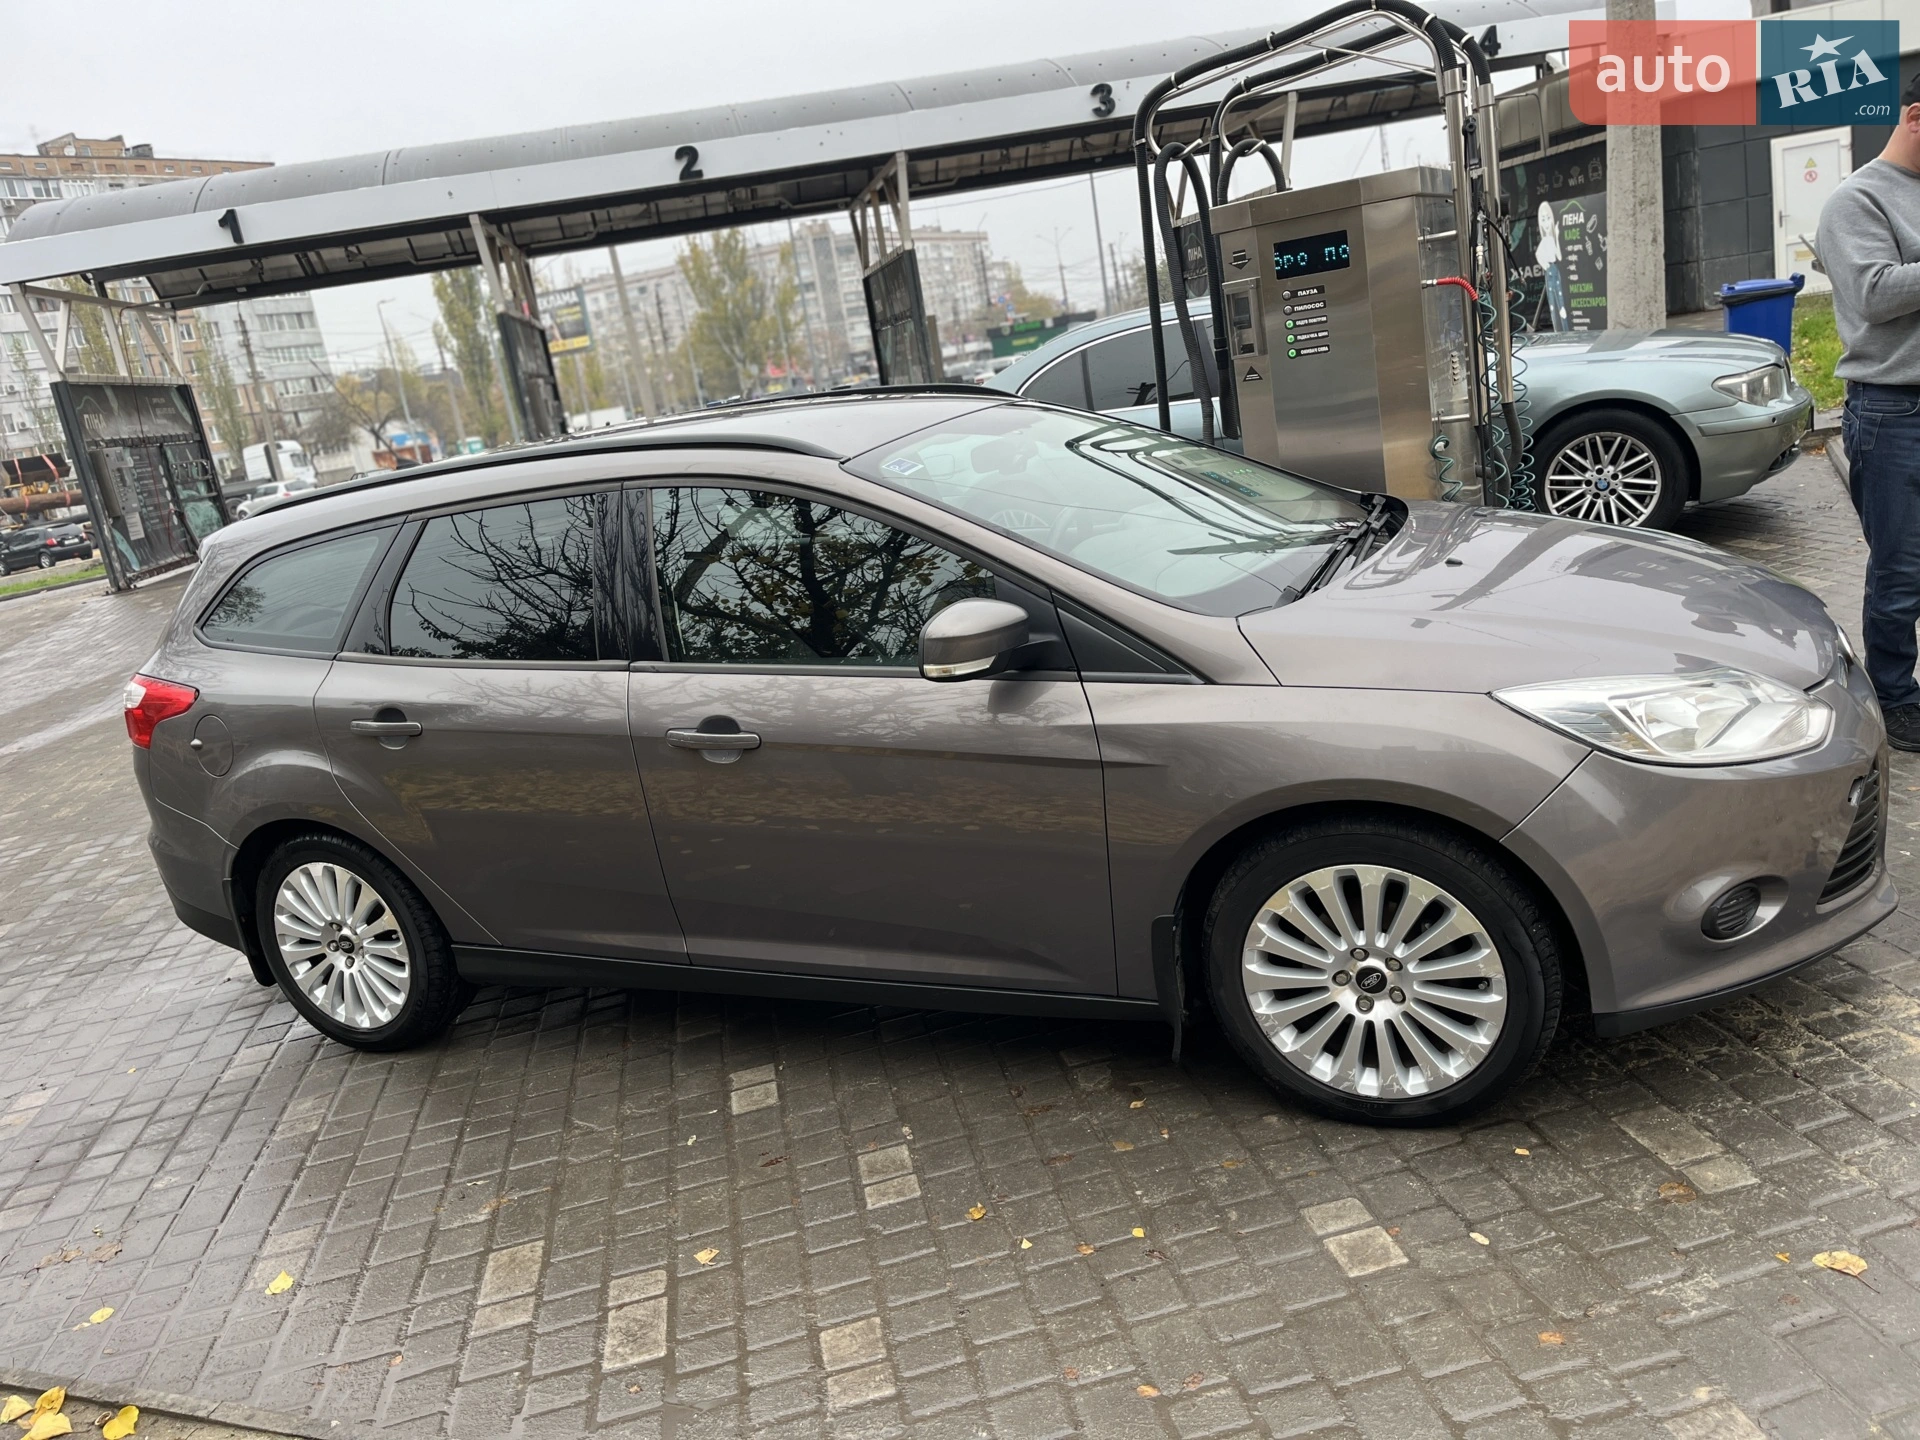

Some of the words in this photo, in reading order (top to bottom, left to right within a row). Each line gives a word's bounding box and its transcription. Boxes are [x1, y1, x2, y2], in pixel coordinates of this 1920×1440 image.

[1478, 24, 1502, 58] 4
[1090, 82, 1116, 118] 3
[674, 145, 704, 182] 2
[217, 208, 245, 245] 1
[1562, 211, 1585, 226] ПЕНА
[1297, 288, 1318, 297] ПАУЗА
[1569, 282, 1593, 293] МАГАЗИН
[537, 290, 580, 310] ЕКЛАМА
[1294, 302, 1324, 311] ПИЛОСОС
[83, 413, 107, 430] ПІНА
